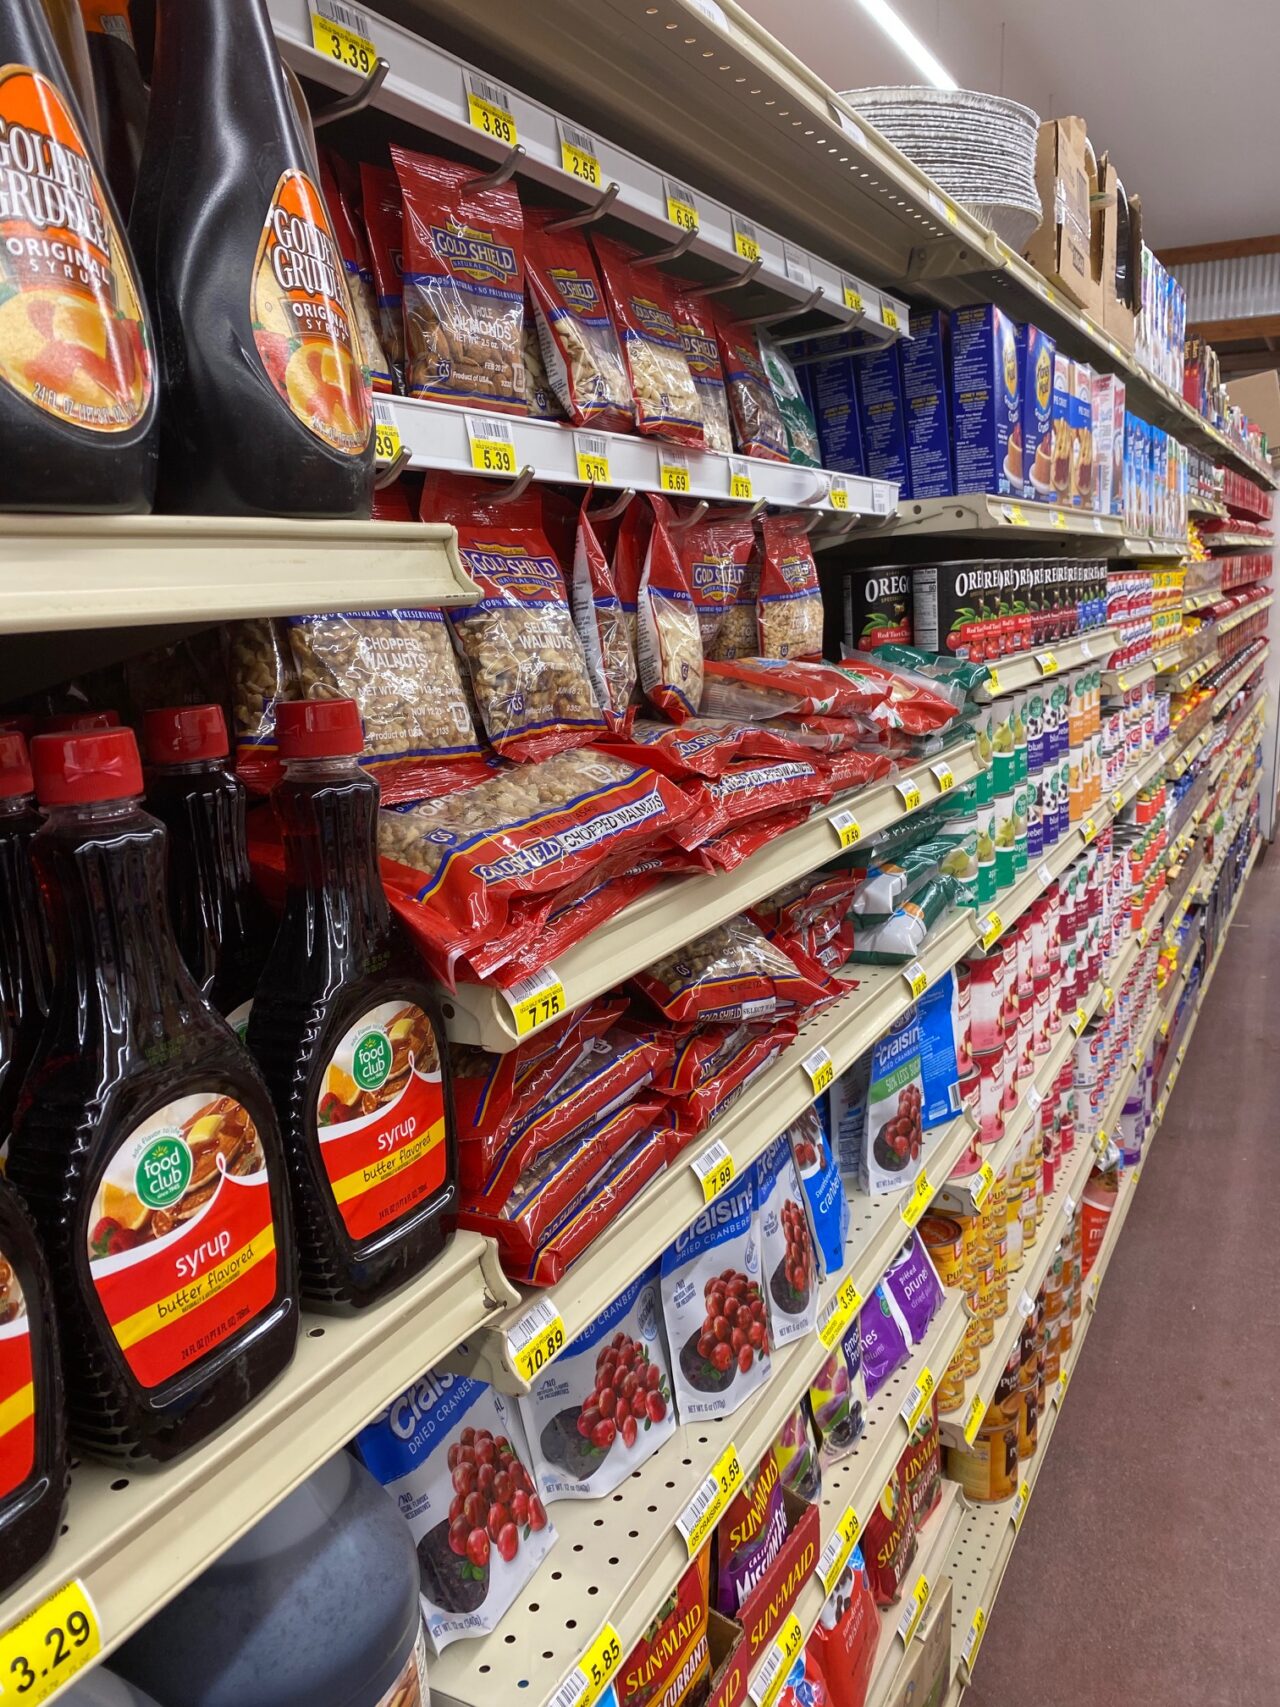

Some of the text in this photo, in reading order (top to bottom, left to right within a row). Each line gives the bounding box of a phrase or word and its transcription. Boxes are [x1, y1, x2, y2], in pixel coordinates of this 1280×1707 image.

[331, 34, 369, 73] 3.39
[482, 111, 511, 142] 3.89
[572, 156, 596, 183] 2.55
[6, 237, 110, 285] ORIGINAL
[437, 233, 513, 270] GOLD SHIELD
[292, 303, 350, 337] ORIGINAL
[484, 450, 510, 471] 5.39
[668, 475, 686, 491] 6.69
[472, 554, 557, 578] GOLD SHIELD
[695, 567, 713, 584] GOLD
[363, 636, 421, 651] CHOPPED
[519, 635, 573, 650] WALNUTS
[362, 652, 428, 670] WALNUTS
[564, 794, 664, 848] CHOPPED WALNUTS
[529, 995, 560, 1027] 7.75
[358, 1040, 384, 1065] food
[362, 1057, 386, 1079] club
[377, 1116, 417, 1152] syrup
[144, 1146, 181, 1179] food
[363, 1157, 396, 1183] butter
[399, 1130, 432, 1164] flavored
[149, 1166, 182, 1194] club
[711, 1166, 732, 1196] 7.99
[175, 1230, 231, 1278] syrup
[157, 1244, 255, 1319] butter flavored
[899, 1264, 917, 1286] pitted
[840, 1284, 857, 1310] 3.59
[527, 1329, 564, 1377] 10.89
[408, 1420, 436, 1455] DRIED
[721, 1457, 740, 1493] 3.59
[844, 1516, 858, 1544] 4.29
[432, 1626, 443, 1639] NET
[785, 1624, 802, 1658] 4.39
[10, 1609, 91, 1694] 3.29
[591, 1637, 621, 1686] 5.85
